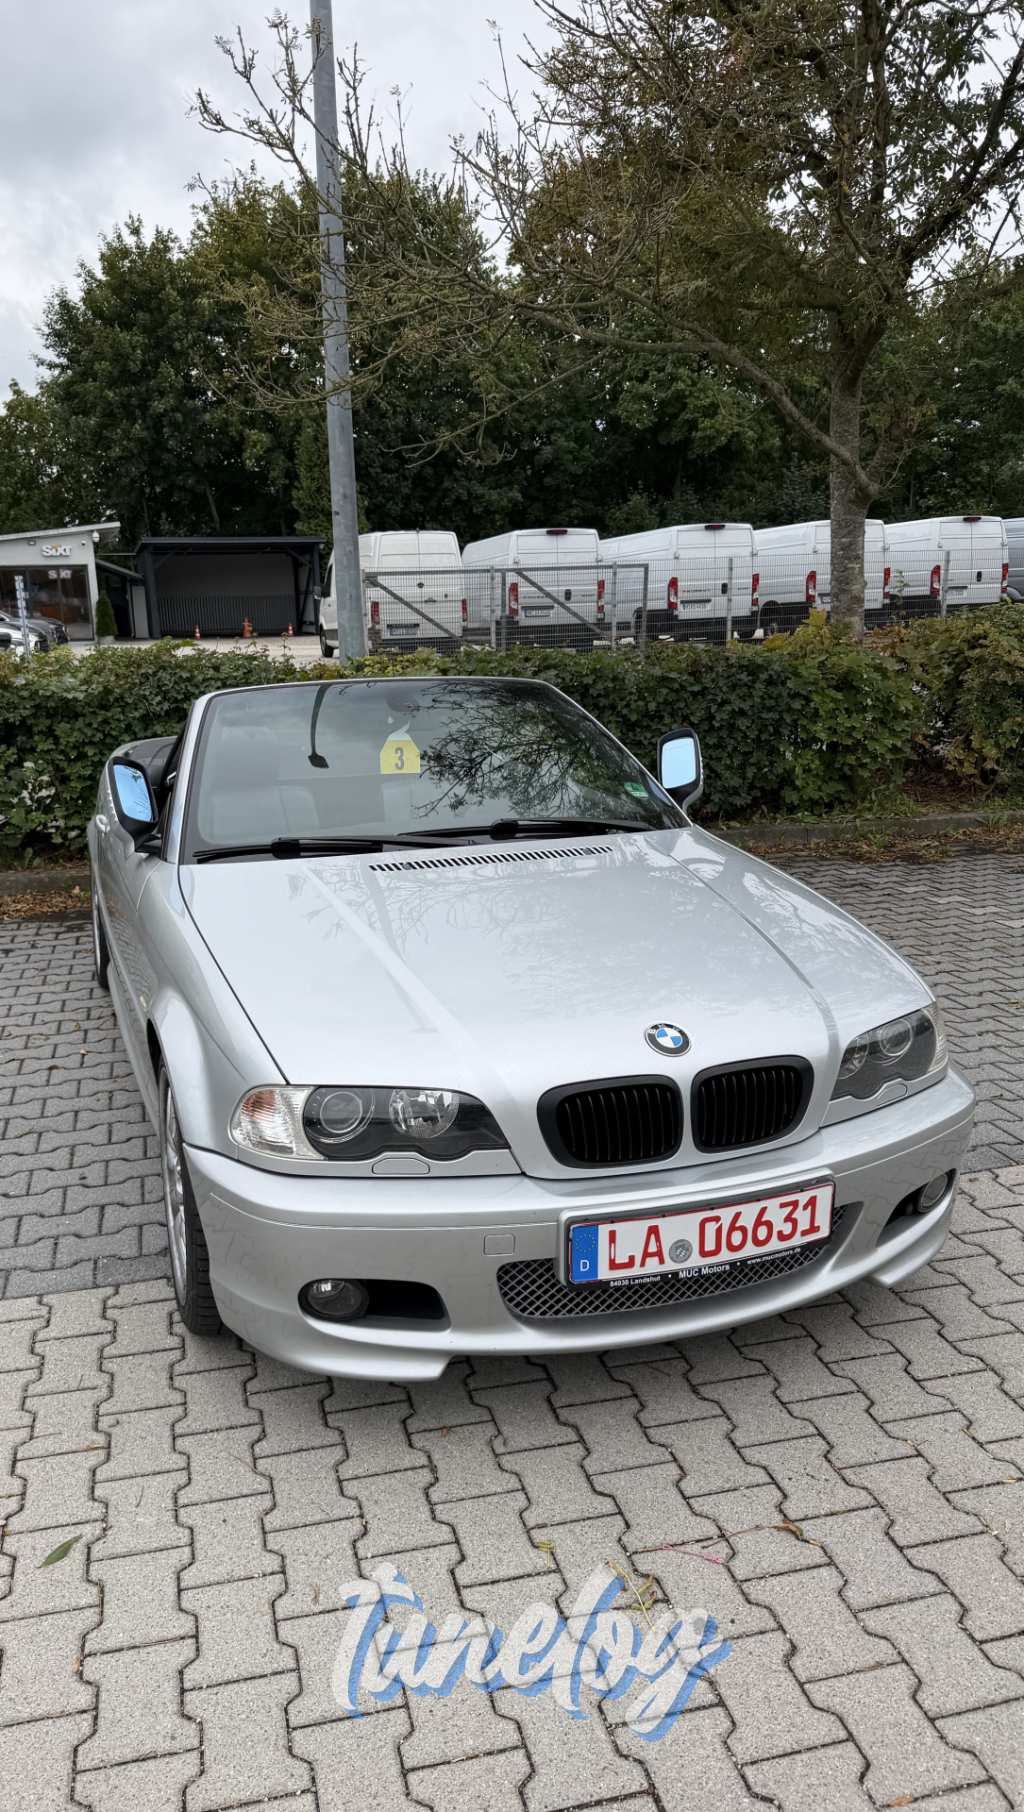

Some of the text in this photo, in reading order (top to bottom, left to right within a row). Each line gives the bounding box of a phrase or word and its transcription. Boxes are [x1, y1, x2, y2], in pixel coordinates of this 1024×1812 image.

[394, 747, 405, 770] 3
[608, 1195, 821, 1271] LA 06631
[579, 1259, 590, 1272] D
[678, 1268, 699, 1279] MUC
[701, 1264, 731, 1275] Motors
